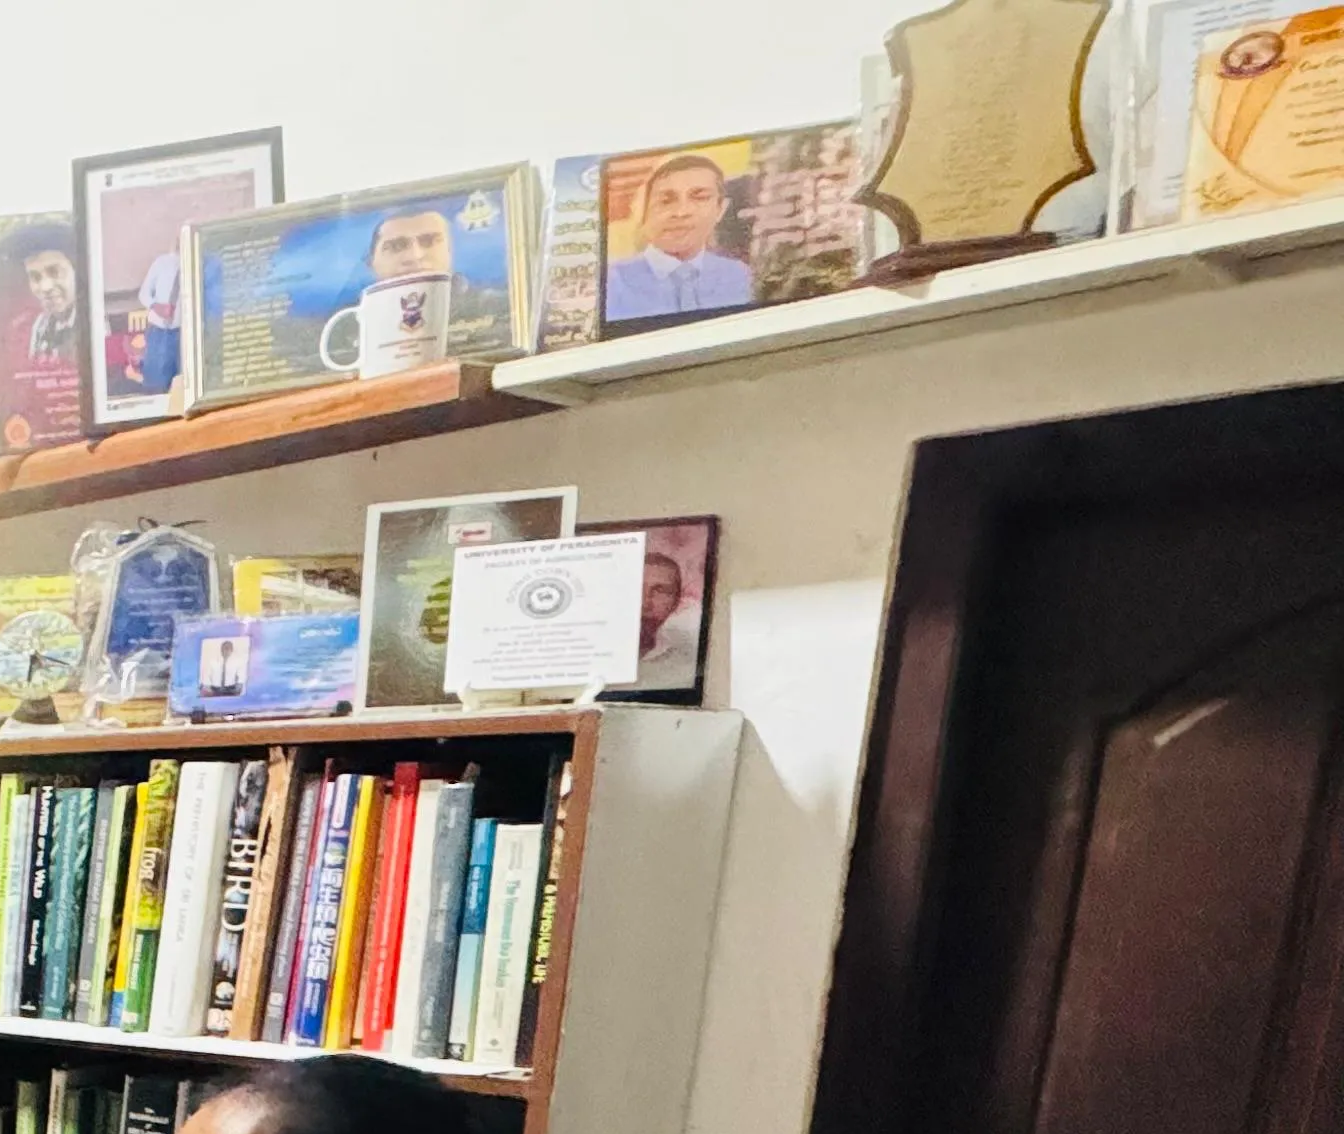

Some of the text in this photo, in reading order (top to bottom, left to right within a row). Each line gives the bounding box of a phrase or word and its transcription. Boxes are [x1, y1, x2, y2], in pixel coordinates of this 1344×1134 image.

[464, 536, 639, 559] UNIVERSITY OF PERADENIYA
[38, 786, 53, 836] HUNTERS
[140, 846, 162, 881] frog
[175, 771, 207, 943] THE PREHISTORY OF SRI LANKA
[32, 869, 46, 899] WILD
[221, 838, 258, 932] BIRD
[532, 964, 548, 984] LIFE
